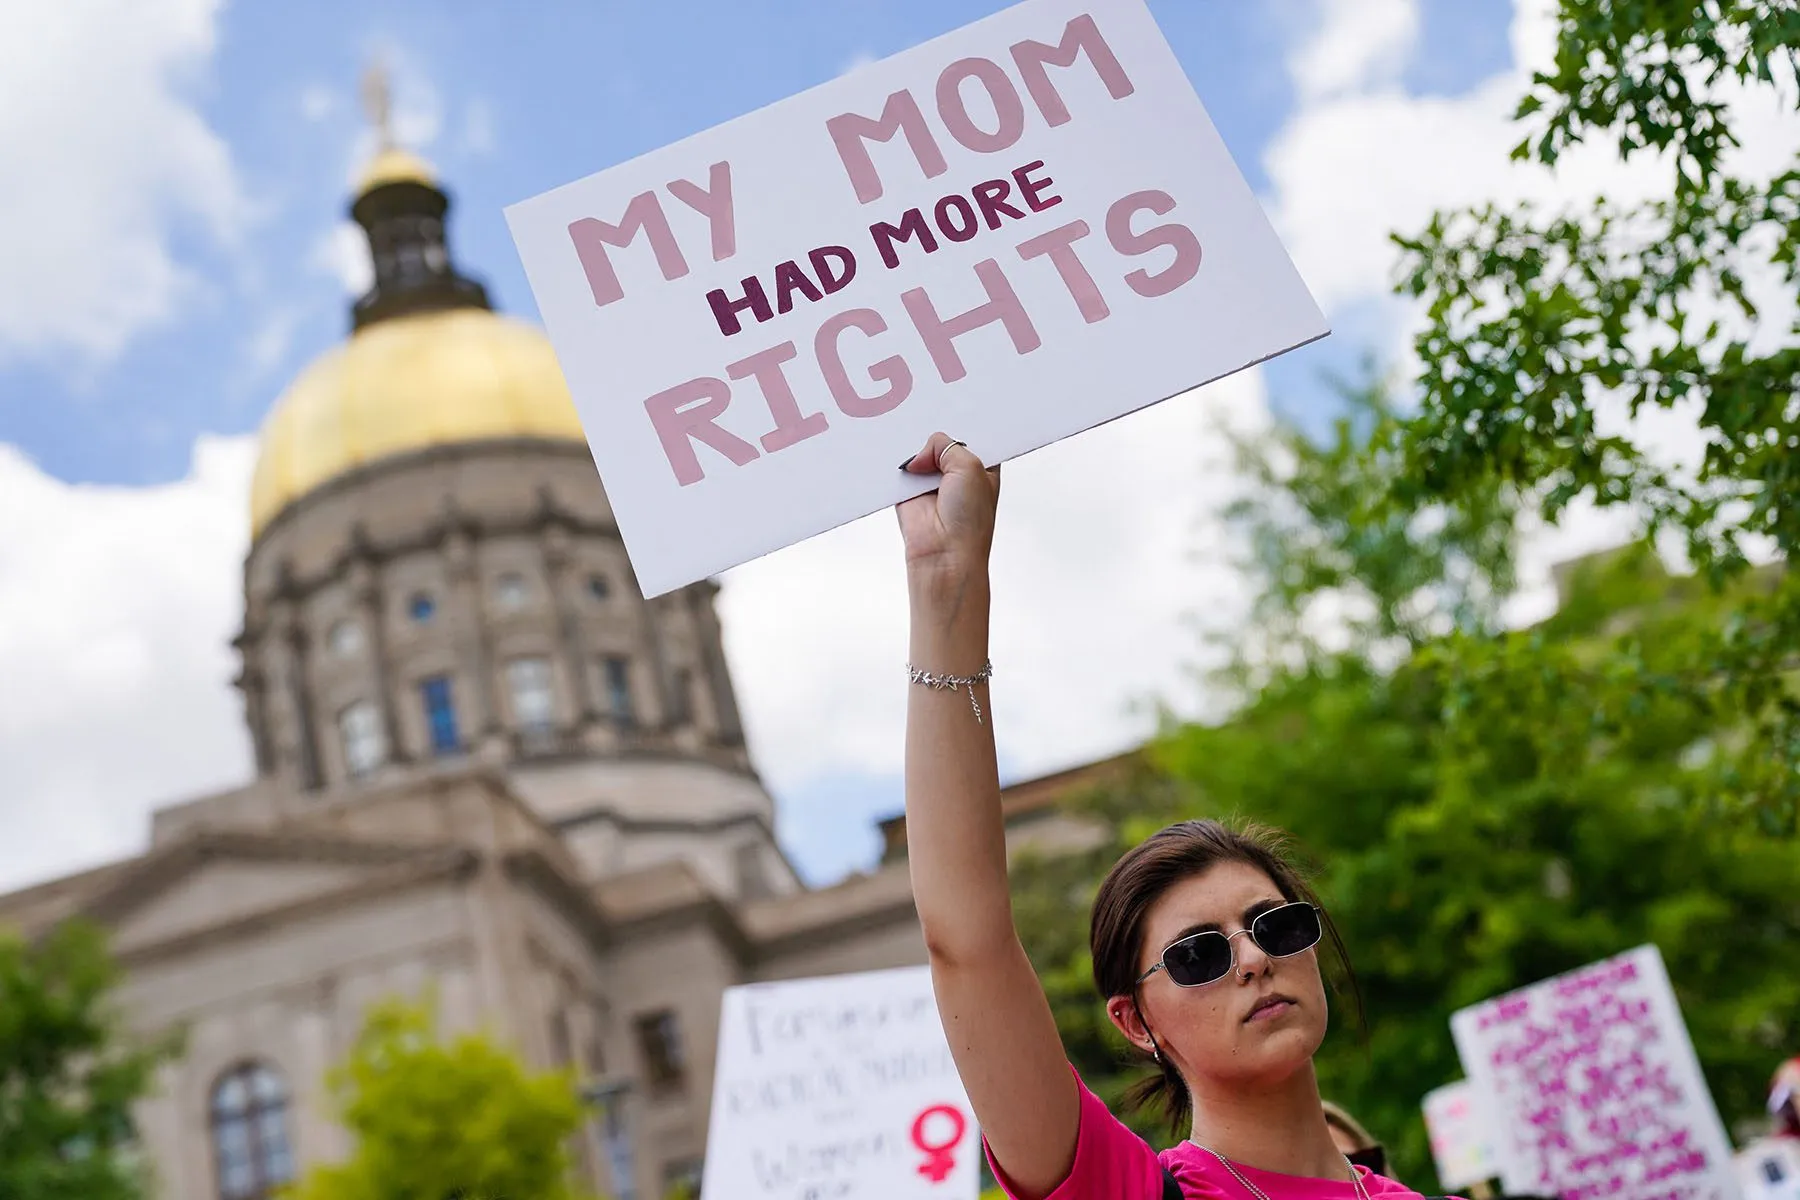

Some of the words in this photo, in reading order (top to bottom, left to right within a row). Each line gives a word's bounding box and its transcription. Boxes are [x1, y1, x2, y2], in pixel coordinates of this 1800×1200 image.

[568, 162, 736, 306] MY
[827, 14, 1134, 204] MOM
[705, 244, 857, 338] HAD
[869, 159, 1064, 270] MORE
[644, 190, 1202, 487] RIGHTS
